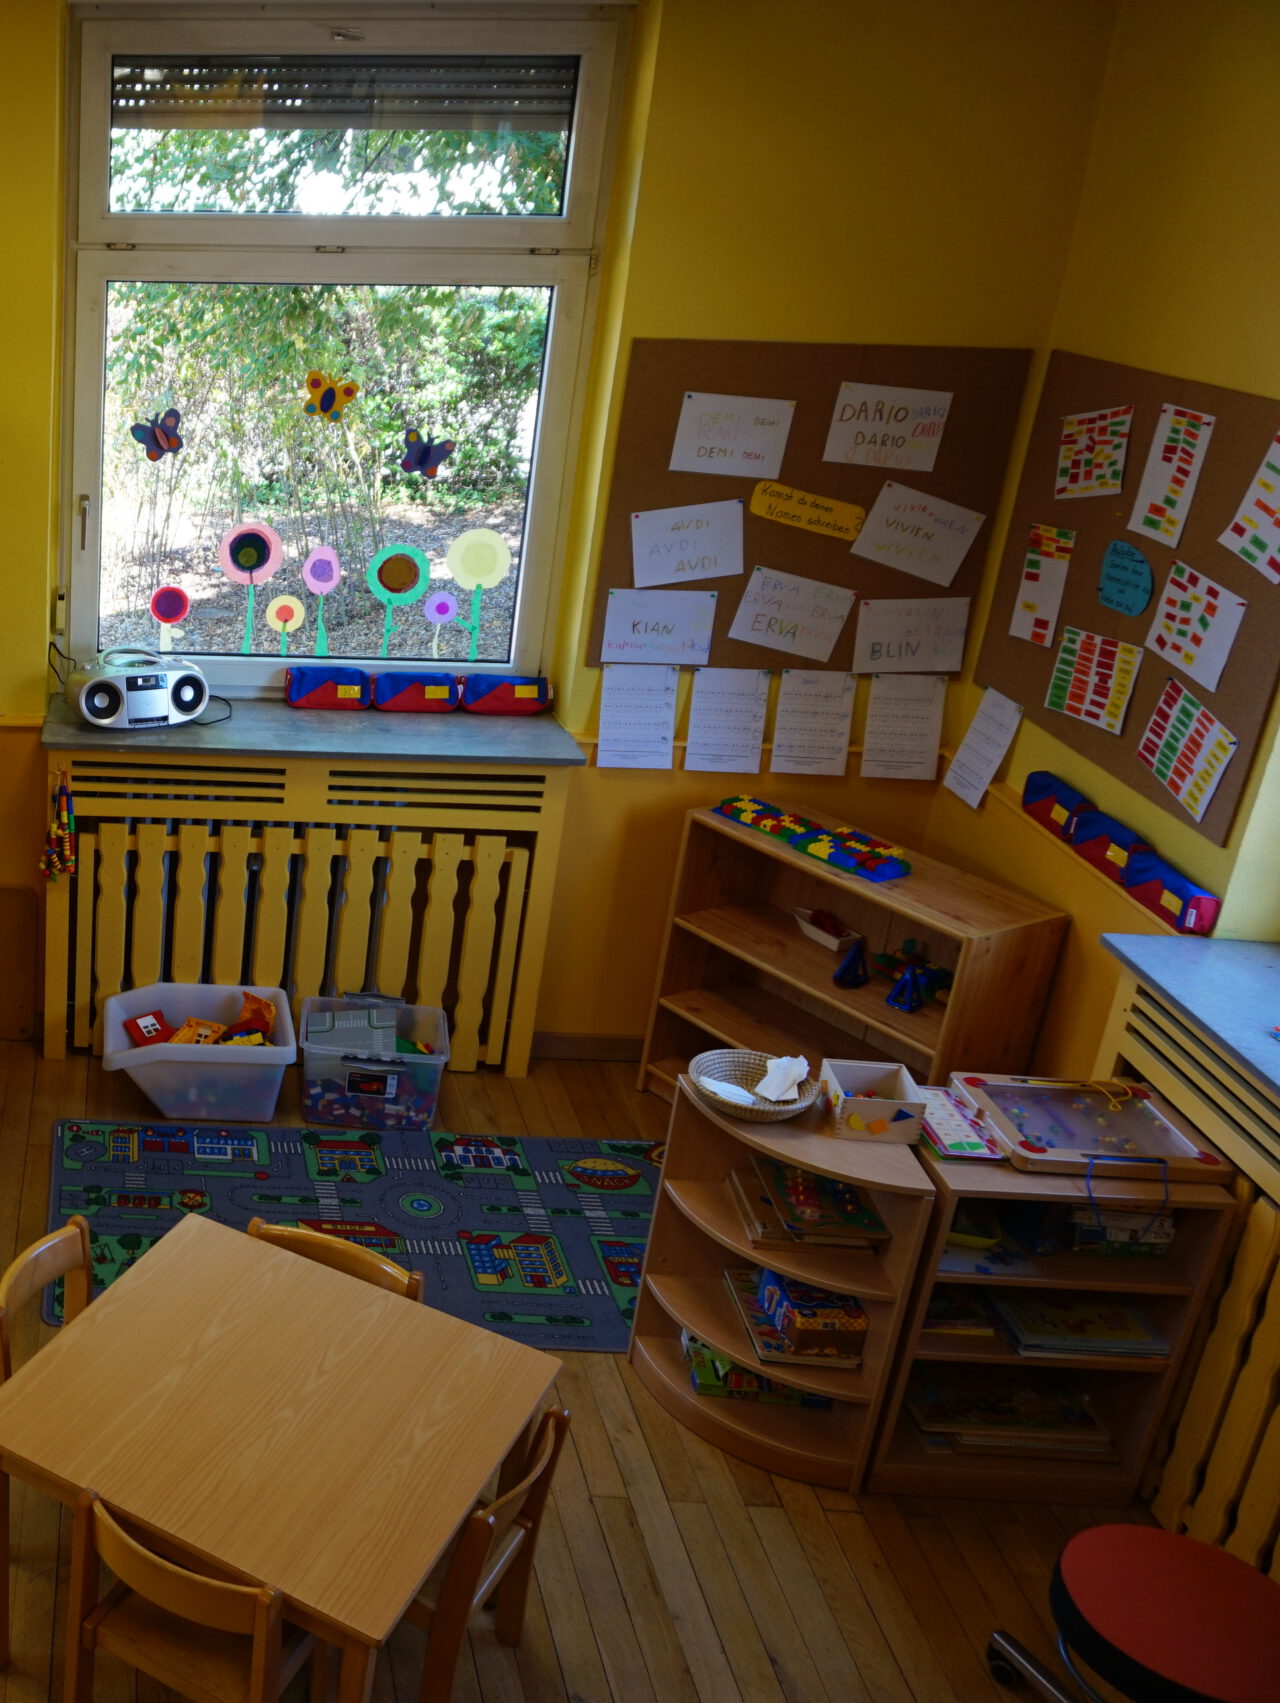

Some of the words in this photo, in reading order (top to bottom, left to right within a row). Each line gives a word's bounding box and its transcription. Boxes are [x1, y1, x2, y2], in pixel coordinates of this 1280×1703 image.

[837, 400, 909, 425] DARIO
[855, 431, 906, 448] DARIO
[697, 446, 734, 459] DEMI
[761, 482, 794, 501] Kannst
[766, 502, 802, 523] Namen
[807, 513, 850, 535] schreiben
[886, 517, 935, 541] VIVIEN
[649, 538, 696, 557] AVDI
[675, 553, 718, 573] AVDI
[744, 590, 783, 611] ERVA
[632, 619, 676, 636] KIAN
[751, 612, 800, 642] ERVA
[870, 640, 921, 661] BLIN
